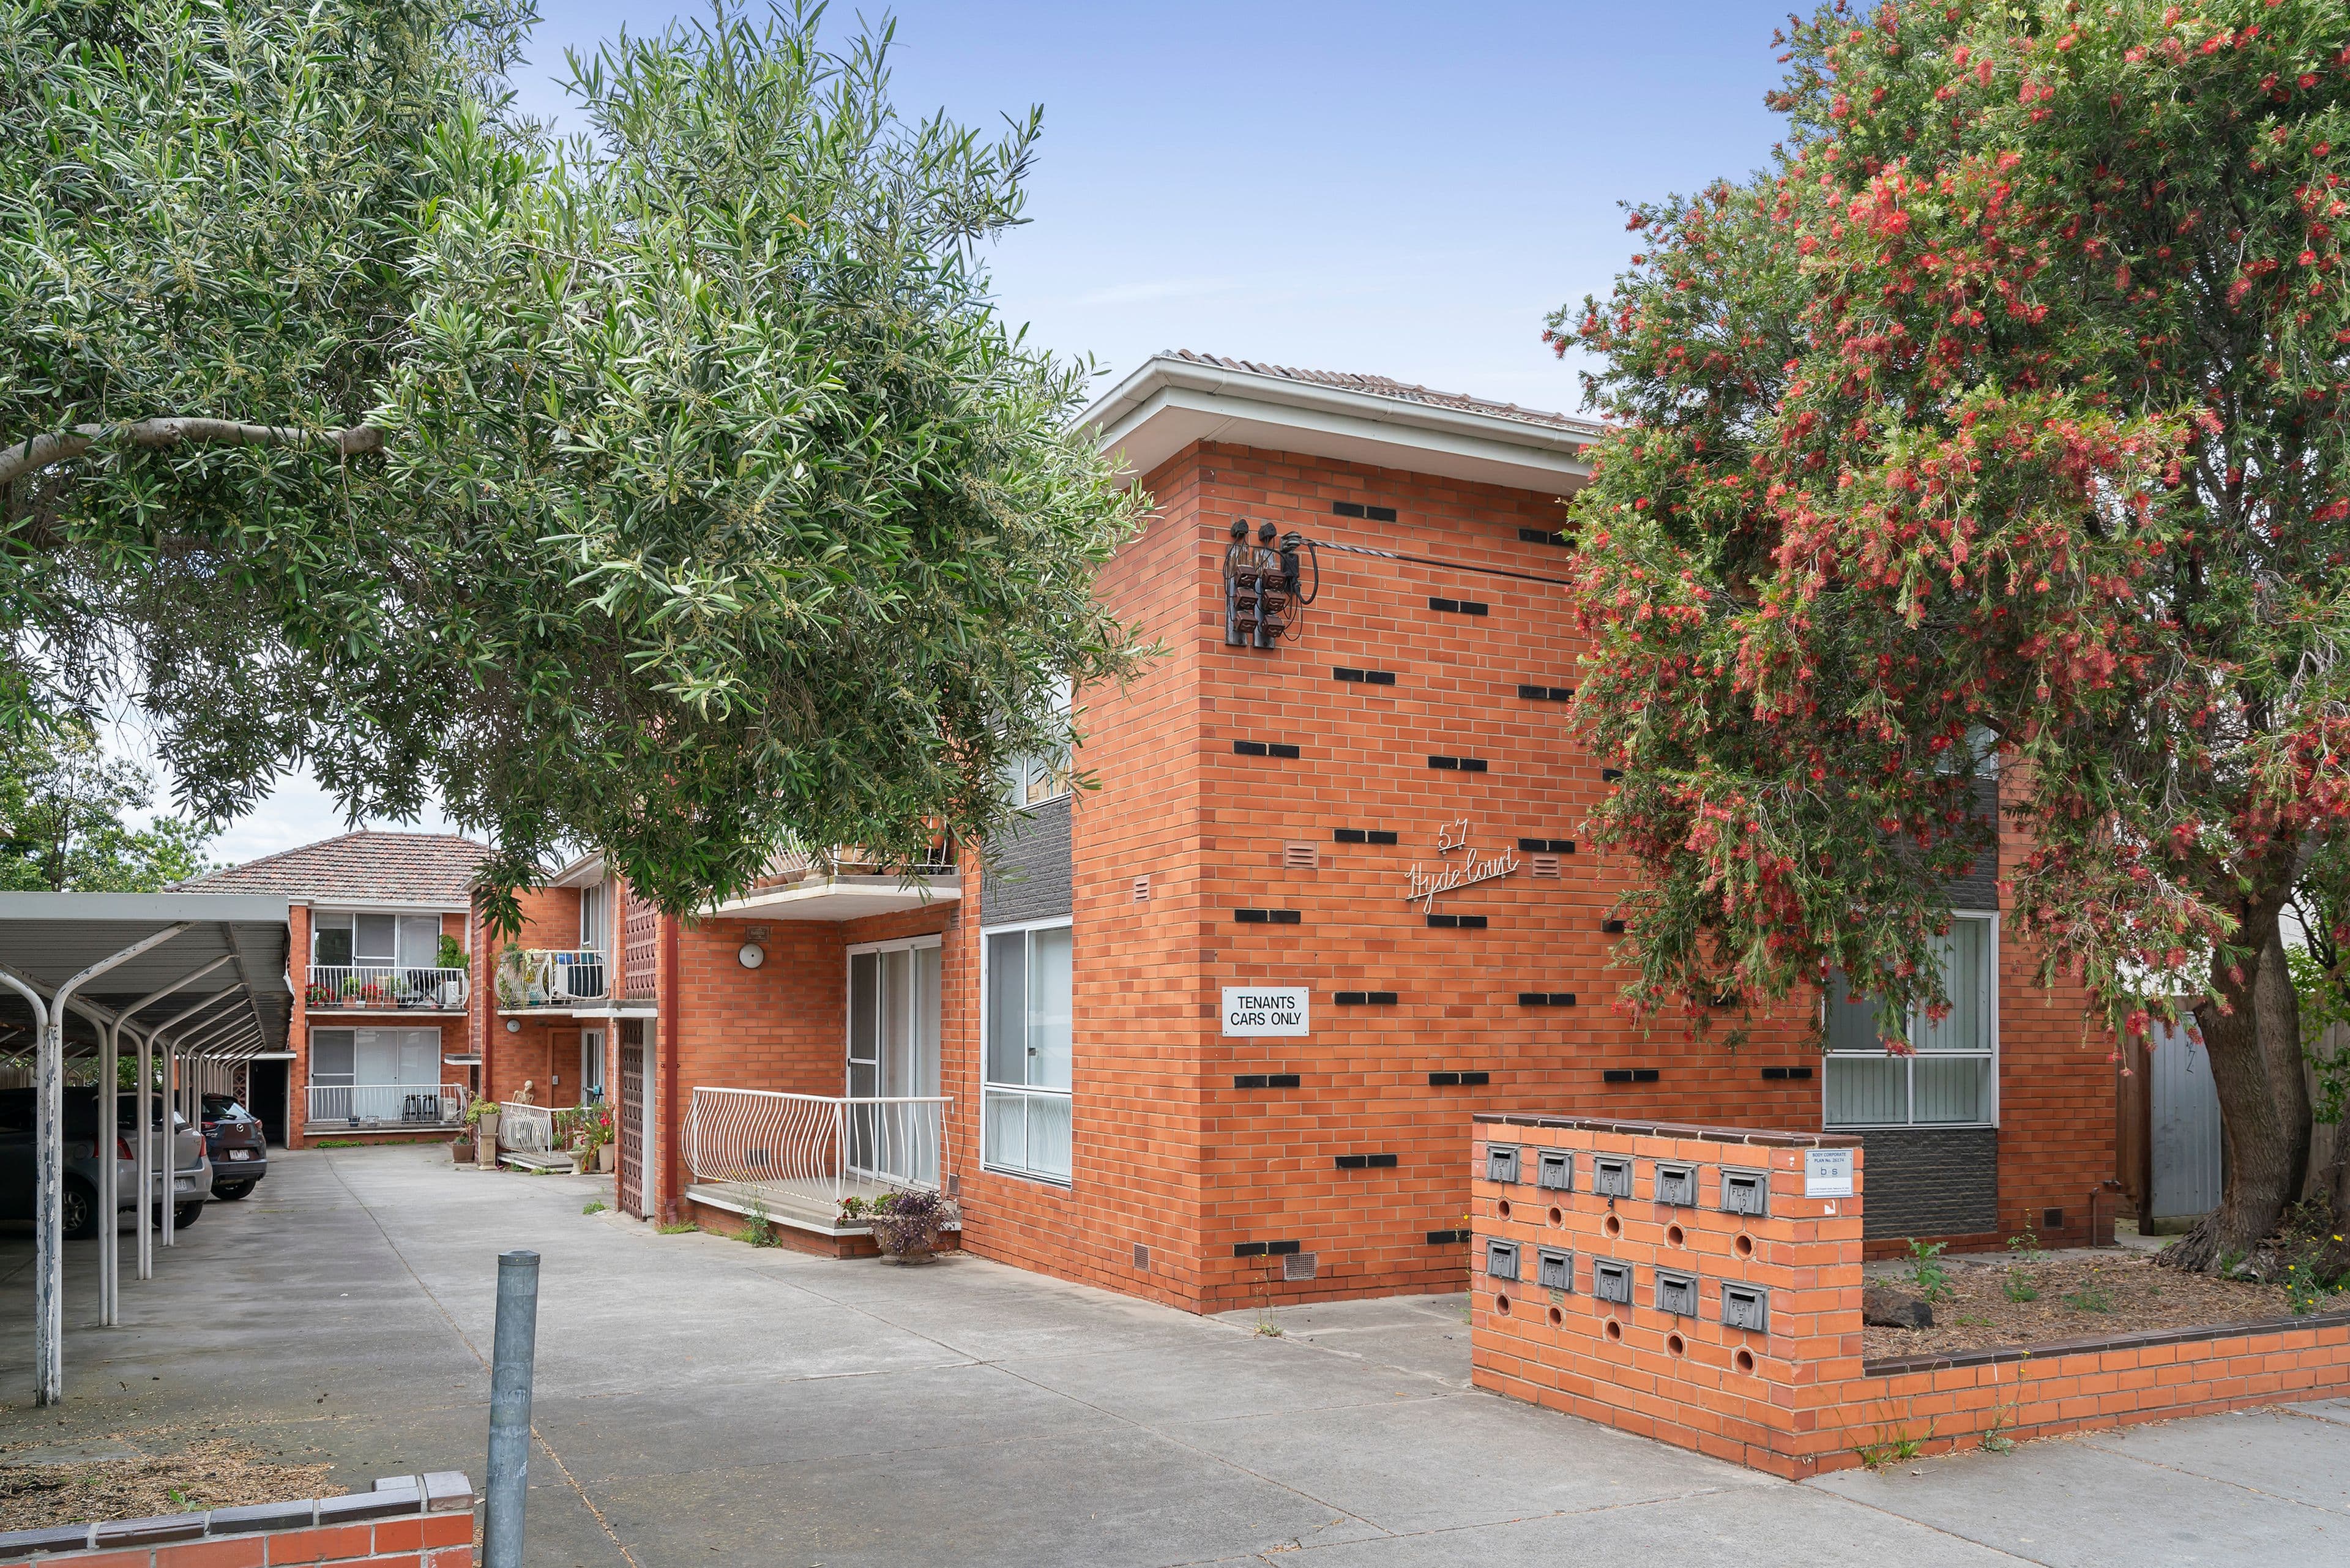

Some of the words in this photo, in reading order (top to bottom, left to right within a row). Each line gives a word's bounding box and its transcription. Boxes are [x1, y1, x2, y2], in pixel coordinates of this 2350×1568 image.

[1438, 818, 1468, 850] 57
[1404, 862, 1461, 914] Hyde
[1464, 845, 1520, 883] Court
[1237, 996, 1296, 1009] TENANTS
[1231, 1012, 1266, 1026] CARS
[1271, 1012, 1302, 1025] ONLY
[1494, 1160, 1509, 1168] FLAT
[1546, 1166, 1561, 1174] FLAT
[1603, 1172, 1620, 1181] FLAT
[1665, 1179, 1683, 1189] FLAT
[1732, 1187, 1752, 1197] FLAT
[1739, 1198, 1747, 1207] 10
[1494, 1255, 1509, 1263] FLAT
[1546, 1264, 1562, 1274] FLAT
[1603, 1277, 1619, 1286] FLAT
[1666, 1288, 1684, 1299] FLAT
[1732, 1301, 1751, 1313] FLAT
